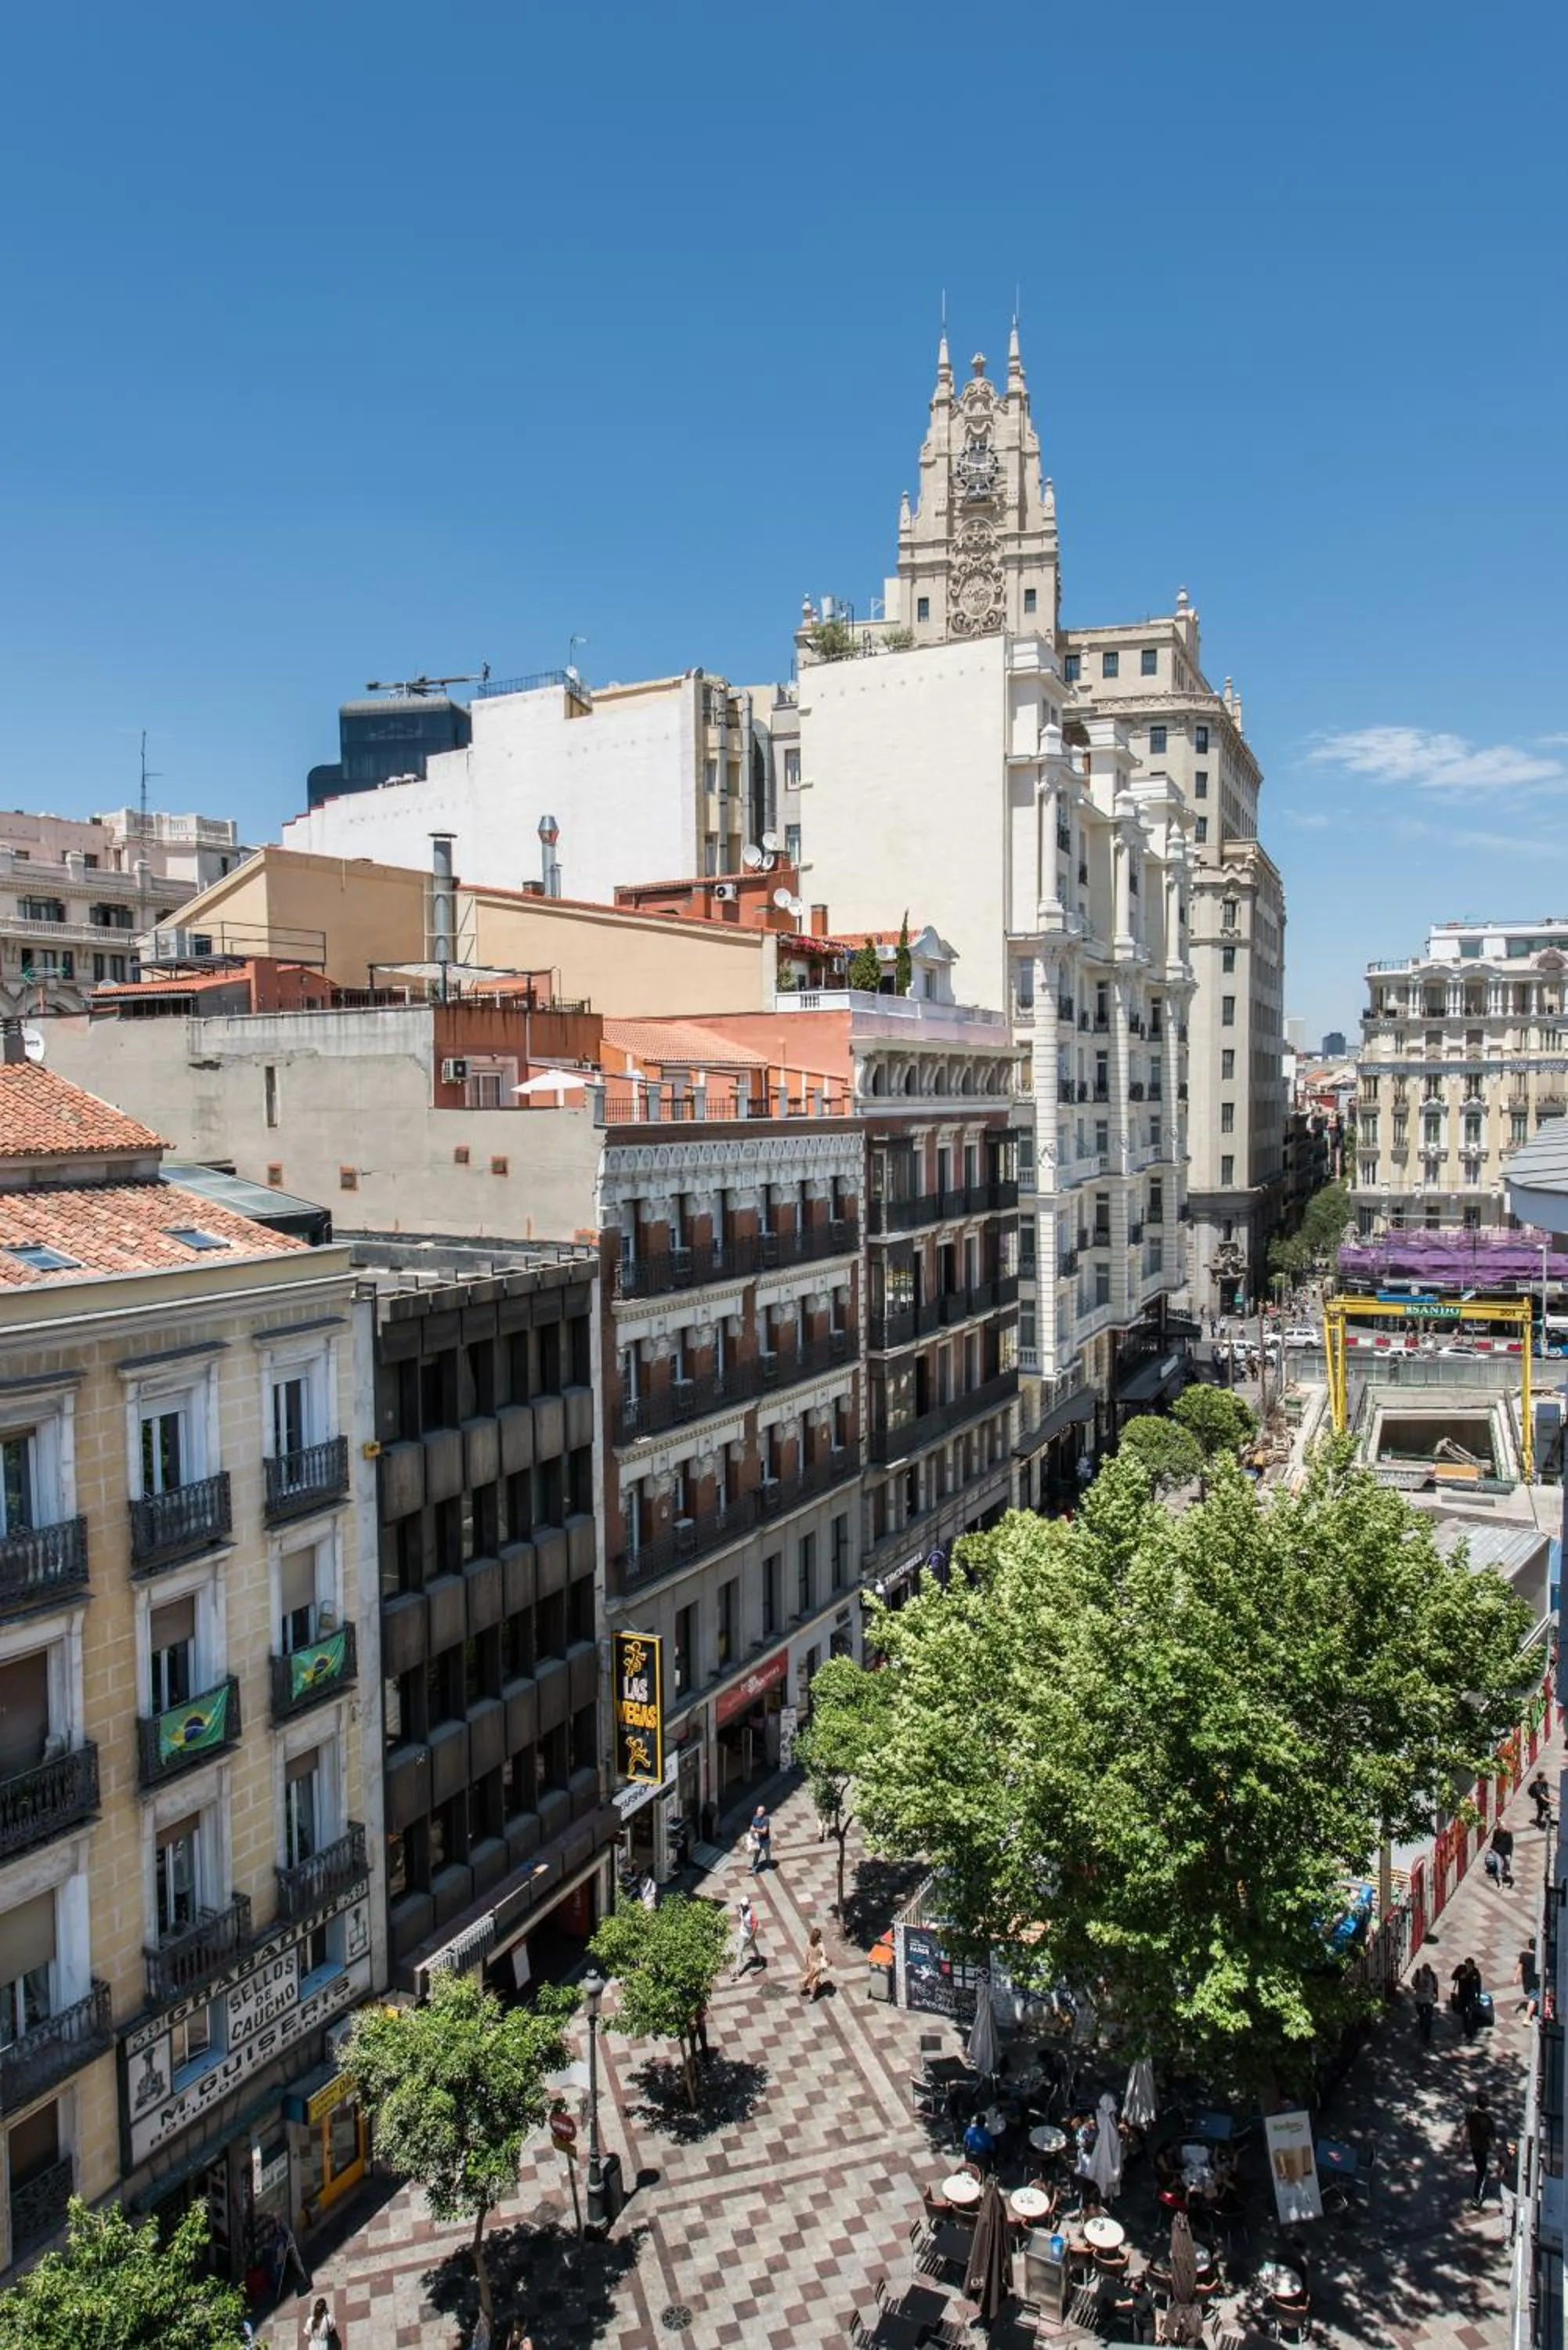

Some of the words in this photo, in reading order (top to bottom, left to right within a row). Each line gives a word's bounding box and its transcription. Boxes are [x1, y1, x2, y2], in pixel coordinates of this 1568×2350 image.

[1410, 1304, 1460, 1315] SANDO
[620, 1701, 657, 1728] VEGAS
[623, 1676, 649, 1702] LAS
[168, 1905, 338, 2024] GRABADOR
[229, 1958, 294, 2014] SELLOS
[231, 1982, 296, 2041] CAUCHO
[255, 1987, 273, 2008] DE
[161, 2101, 191, 2128] M.
[198, 1976, 350, 2097] GUISERIS
[150, 2070, 244, 2147] ROTULOS
[251, 2048, 273, 2070] EN
